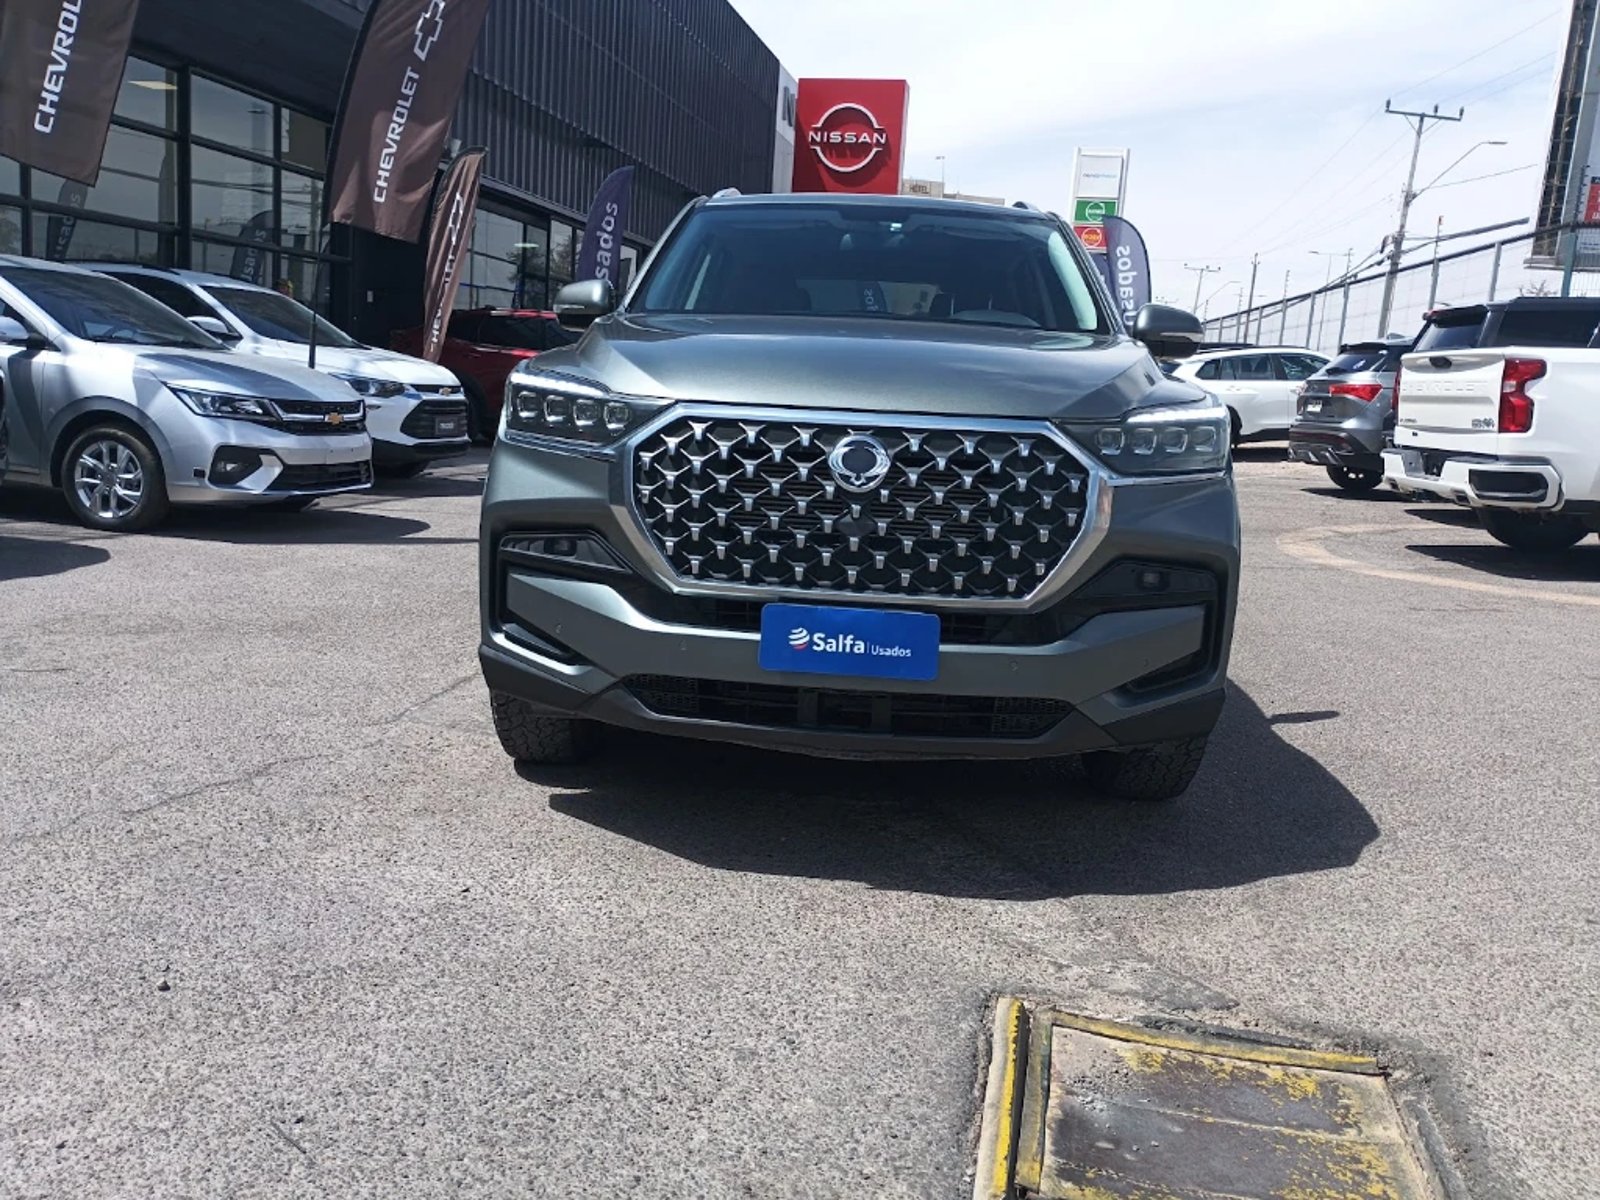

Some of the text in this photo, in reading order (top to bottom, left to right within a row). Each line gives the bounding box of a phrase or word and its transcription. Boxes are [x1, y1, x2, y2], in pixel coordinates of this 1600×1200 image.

[34, 0, 82, 134] CHEVROL
[373, 66, 420, 203] CHEVROLET
[808, 131, 887, 145] NISSAN
[595, 202, 618, 281] sados
[812, 631, 912, 657] Salfa Usados
